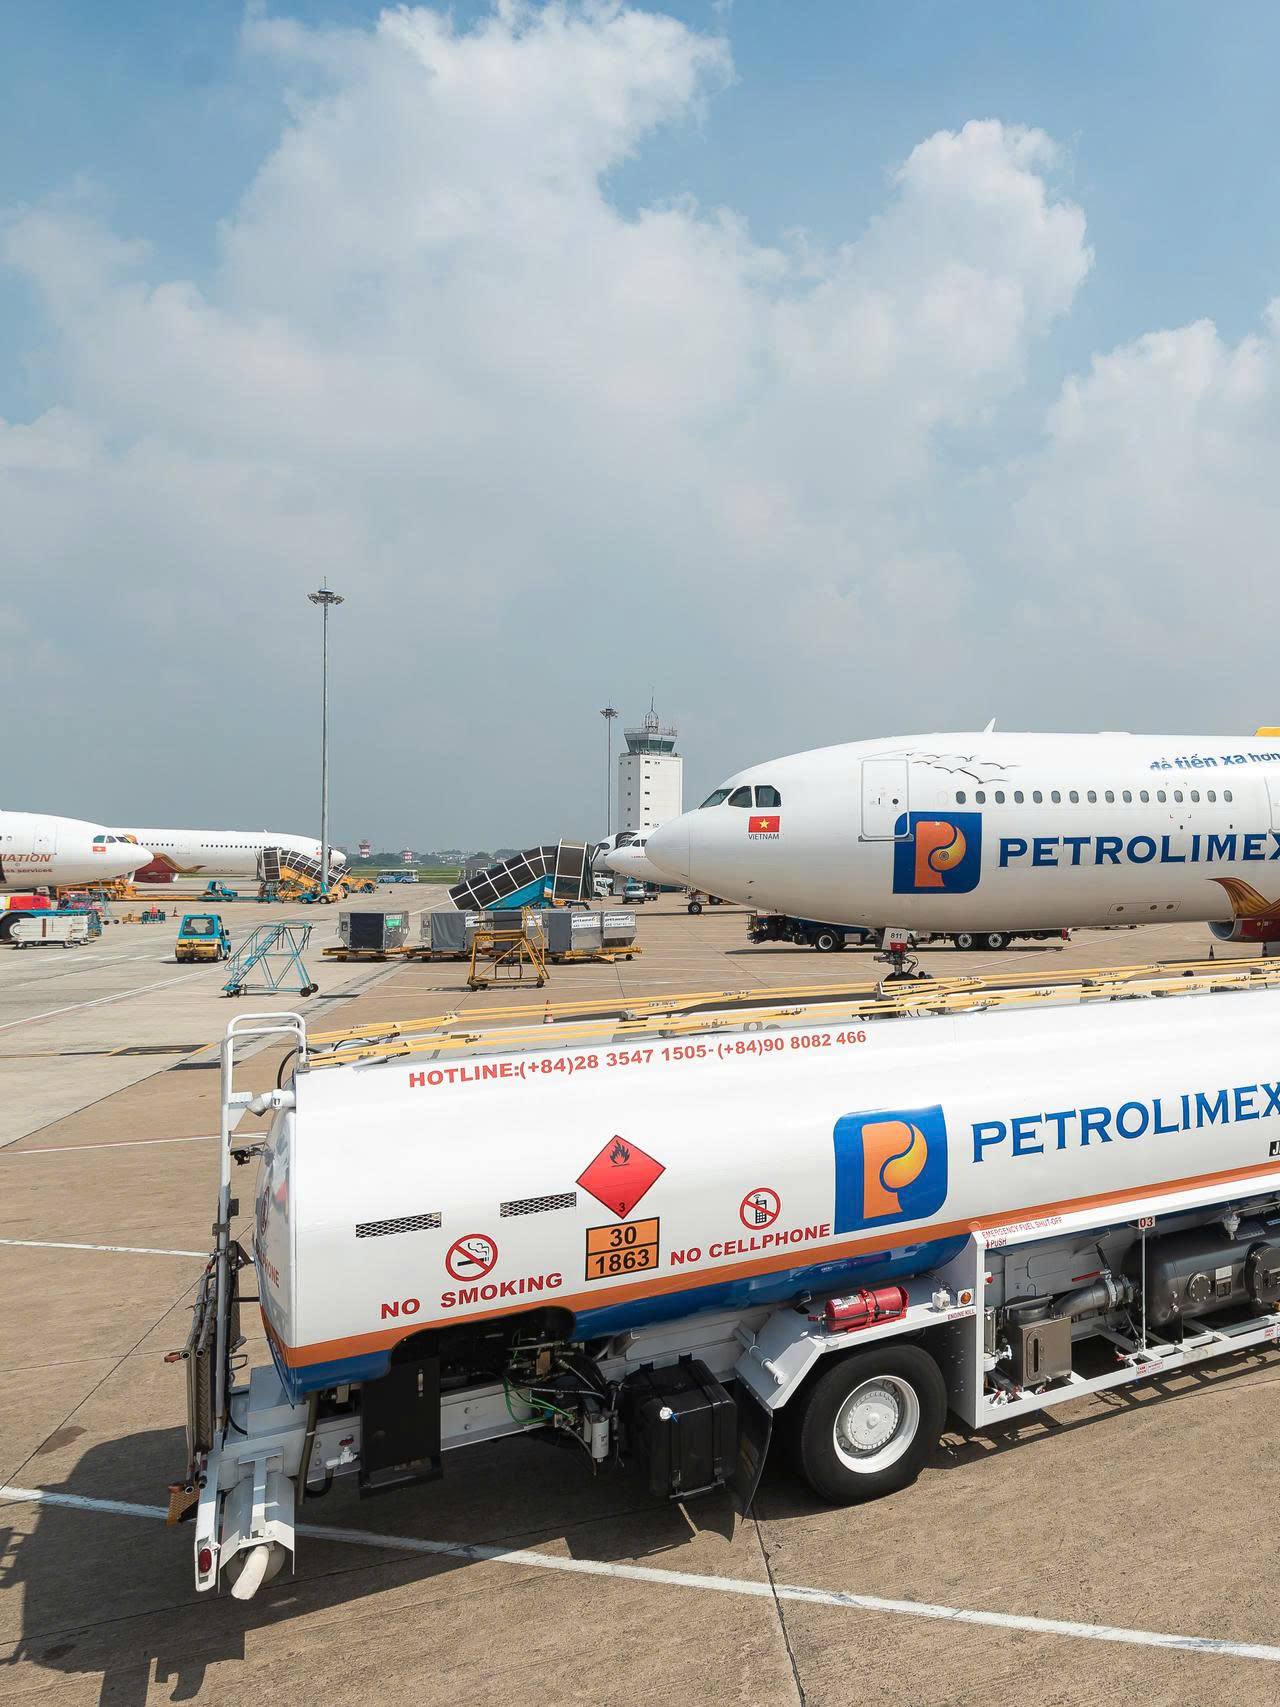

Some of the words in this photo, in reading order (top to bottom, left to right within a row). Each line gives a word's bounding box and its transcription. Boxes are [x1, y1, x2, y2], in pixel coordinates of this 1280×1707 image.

[1220, 754, 1248, 766] xa
[0, 853, 51, 862] IATION
[606, 1049, 654, 1067] 3547
[790, 1034, 831, 1049] 8082
[836, 1030, 867, 1044] 466
[619, 1202, 625, 1212] 3
[1139, 1217, 1153, 1228] 03
[609, 1226, 637, 1247] 30
[670, 1247, 701, 1265] NO
[709, 1223, 831, 1258] CELLPHONE
[990, 1238, 1007, 1248] PUSH
[595, 1248, 650, 1275] 1863
[381, 1298, 420, 1319] NO
[440, 1272, 563, 1308] SMOKING
